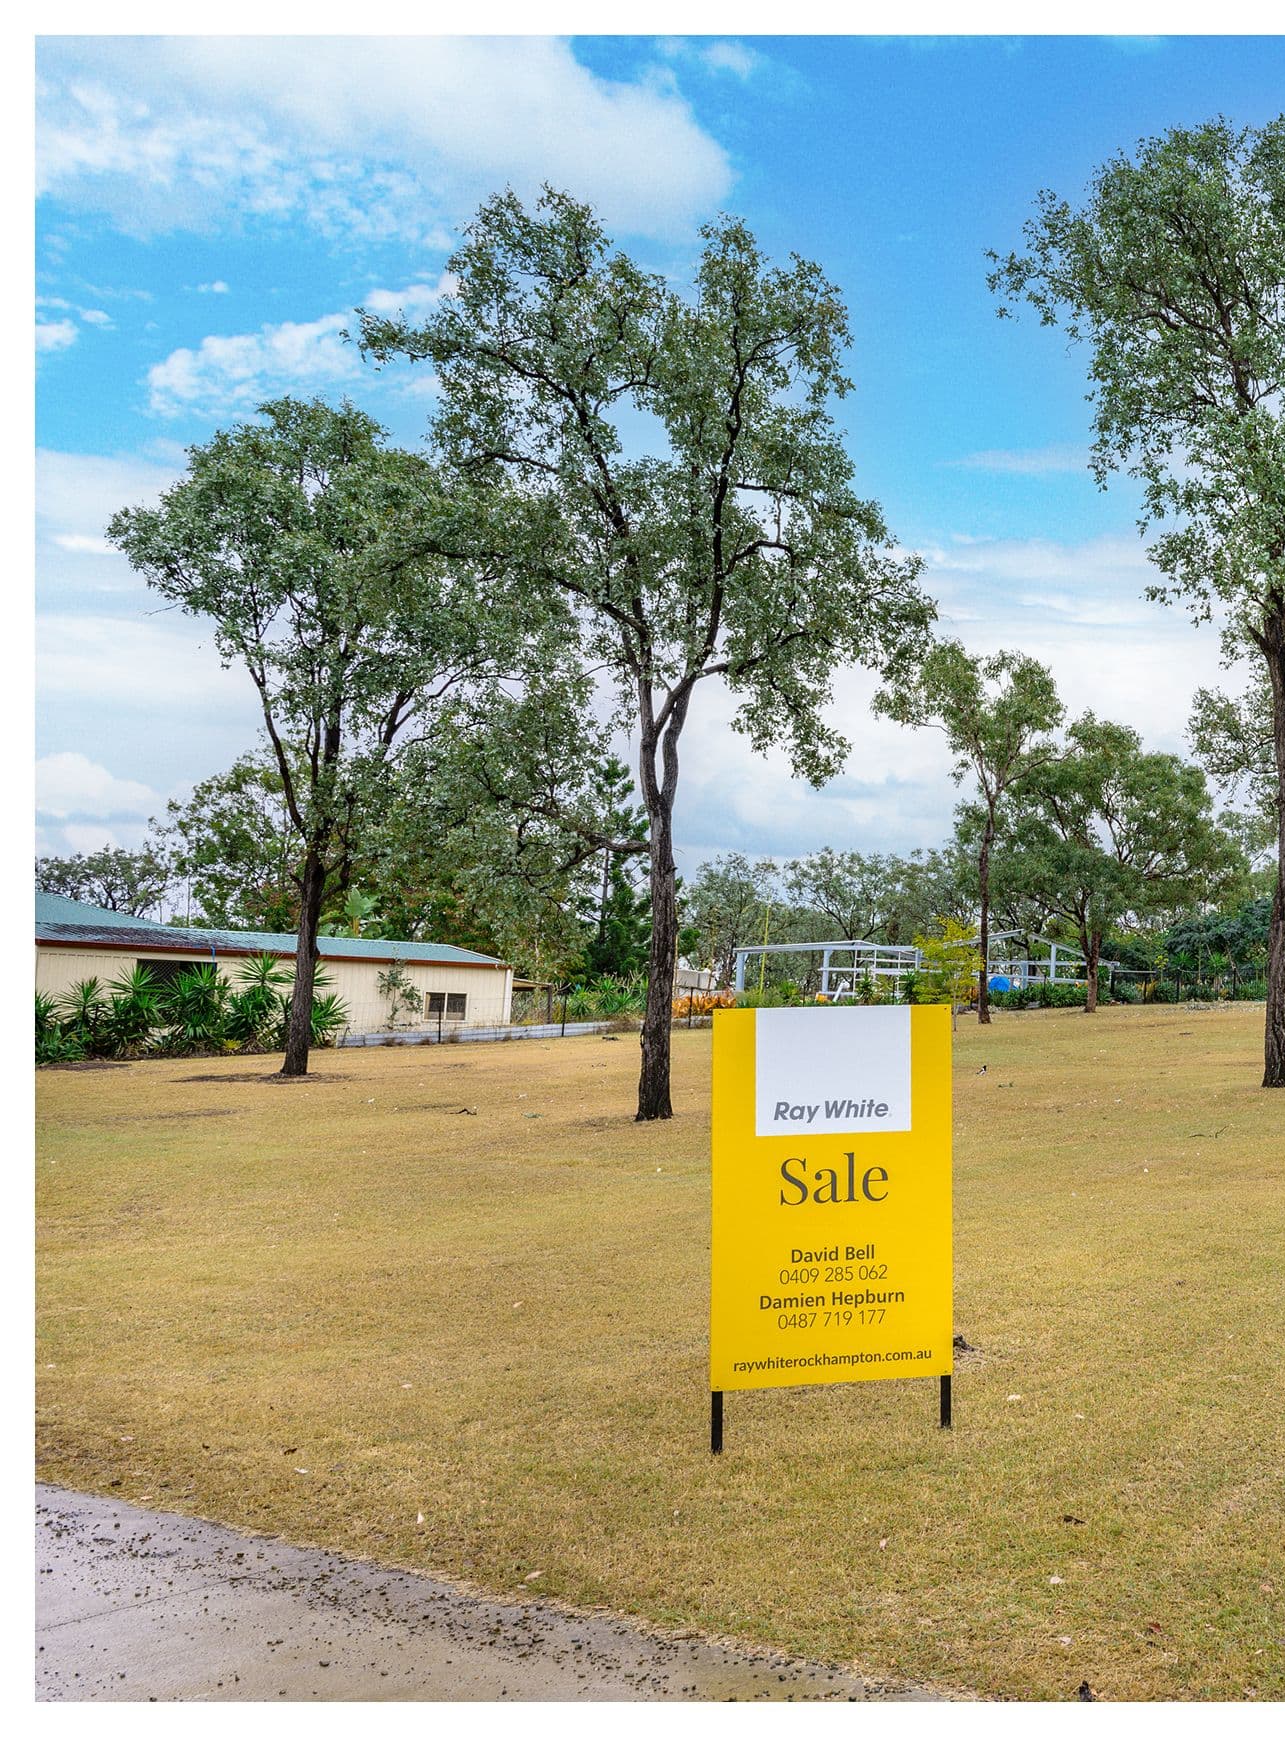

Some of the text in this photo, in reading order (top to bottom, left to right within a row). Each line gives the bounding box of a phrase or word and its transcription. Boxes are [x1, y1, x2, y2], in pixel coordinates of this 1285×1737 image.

[773, 1099, 889, 1123] Ray White
[779, 1152, 889, 1206] Sale
[791, 1245, 875, 1263] David Bell
[779, 1264, 888, 1284] 0409 285 062
[760, 1289, 904, 1310] Damien Hepburn
[778, 1309, 886, 1330] 0487 719 177
[733, 1350, 932, 1373] raywhiterockhampton.com.au
